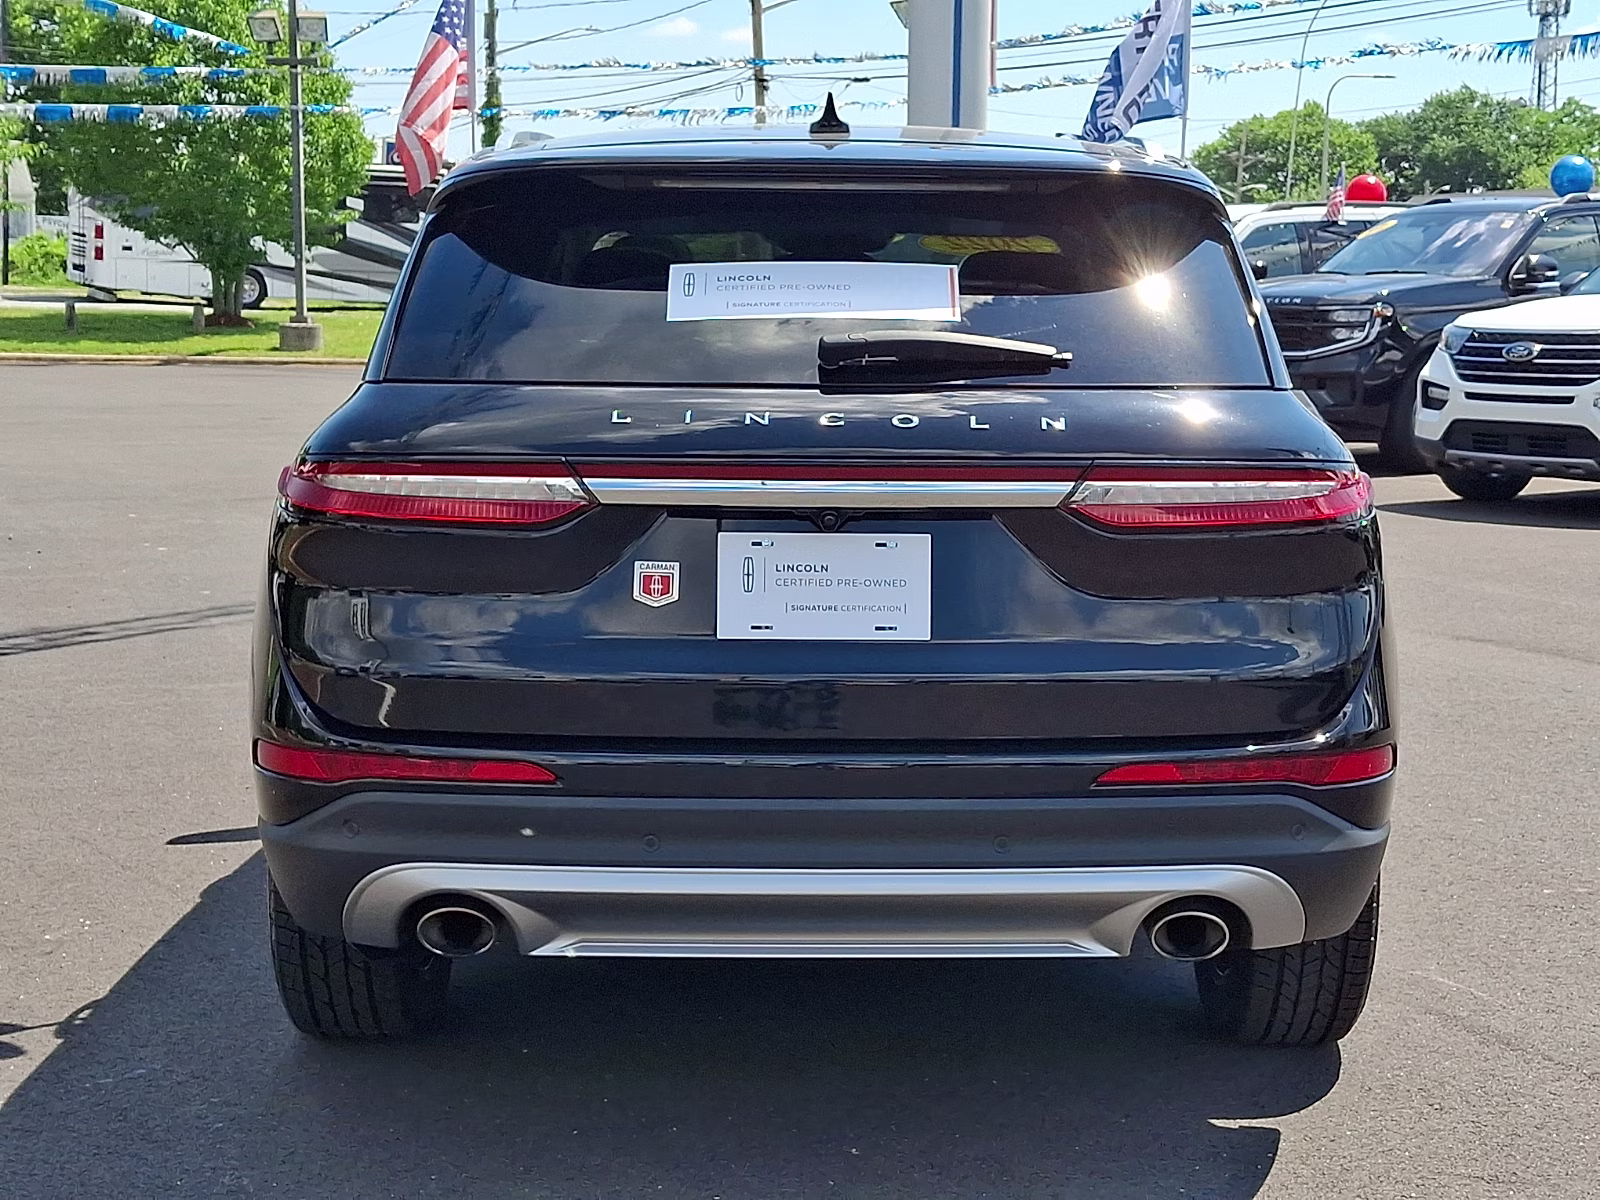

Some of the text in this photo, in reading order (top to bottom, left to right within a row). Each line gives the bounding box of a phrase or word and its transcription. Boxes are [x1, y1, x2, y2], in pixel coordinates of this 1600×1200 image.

[716, 284, 776, 292] CERTIFIED
[611, 410, 1067, 431] LINCOLN
[639, 563, 675, 571] CARMAN
[775, 564, 829, 573] LINCOLN
[775, 578, 907, 588] CERTIFIED PRE-OWNED
[791, 604, 902, 612] SIGNATURE CERTIFICATION
